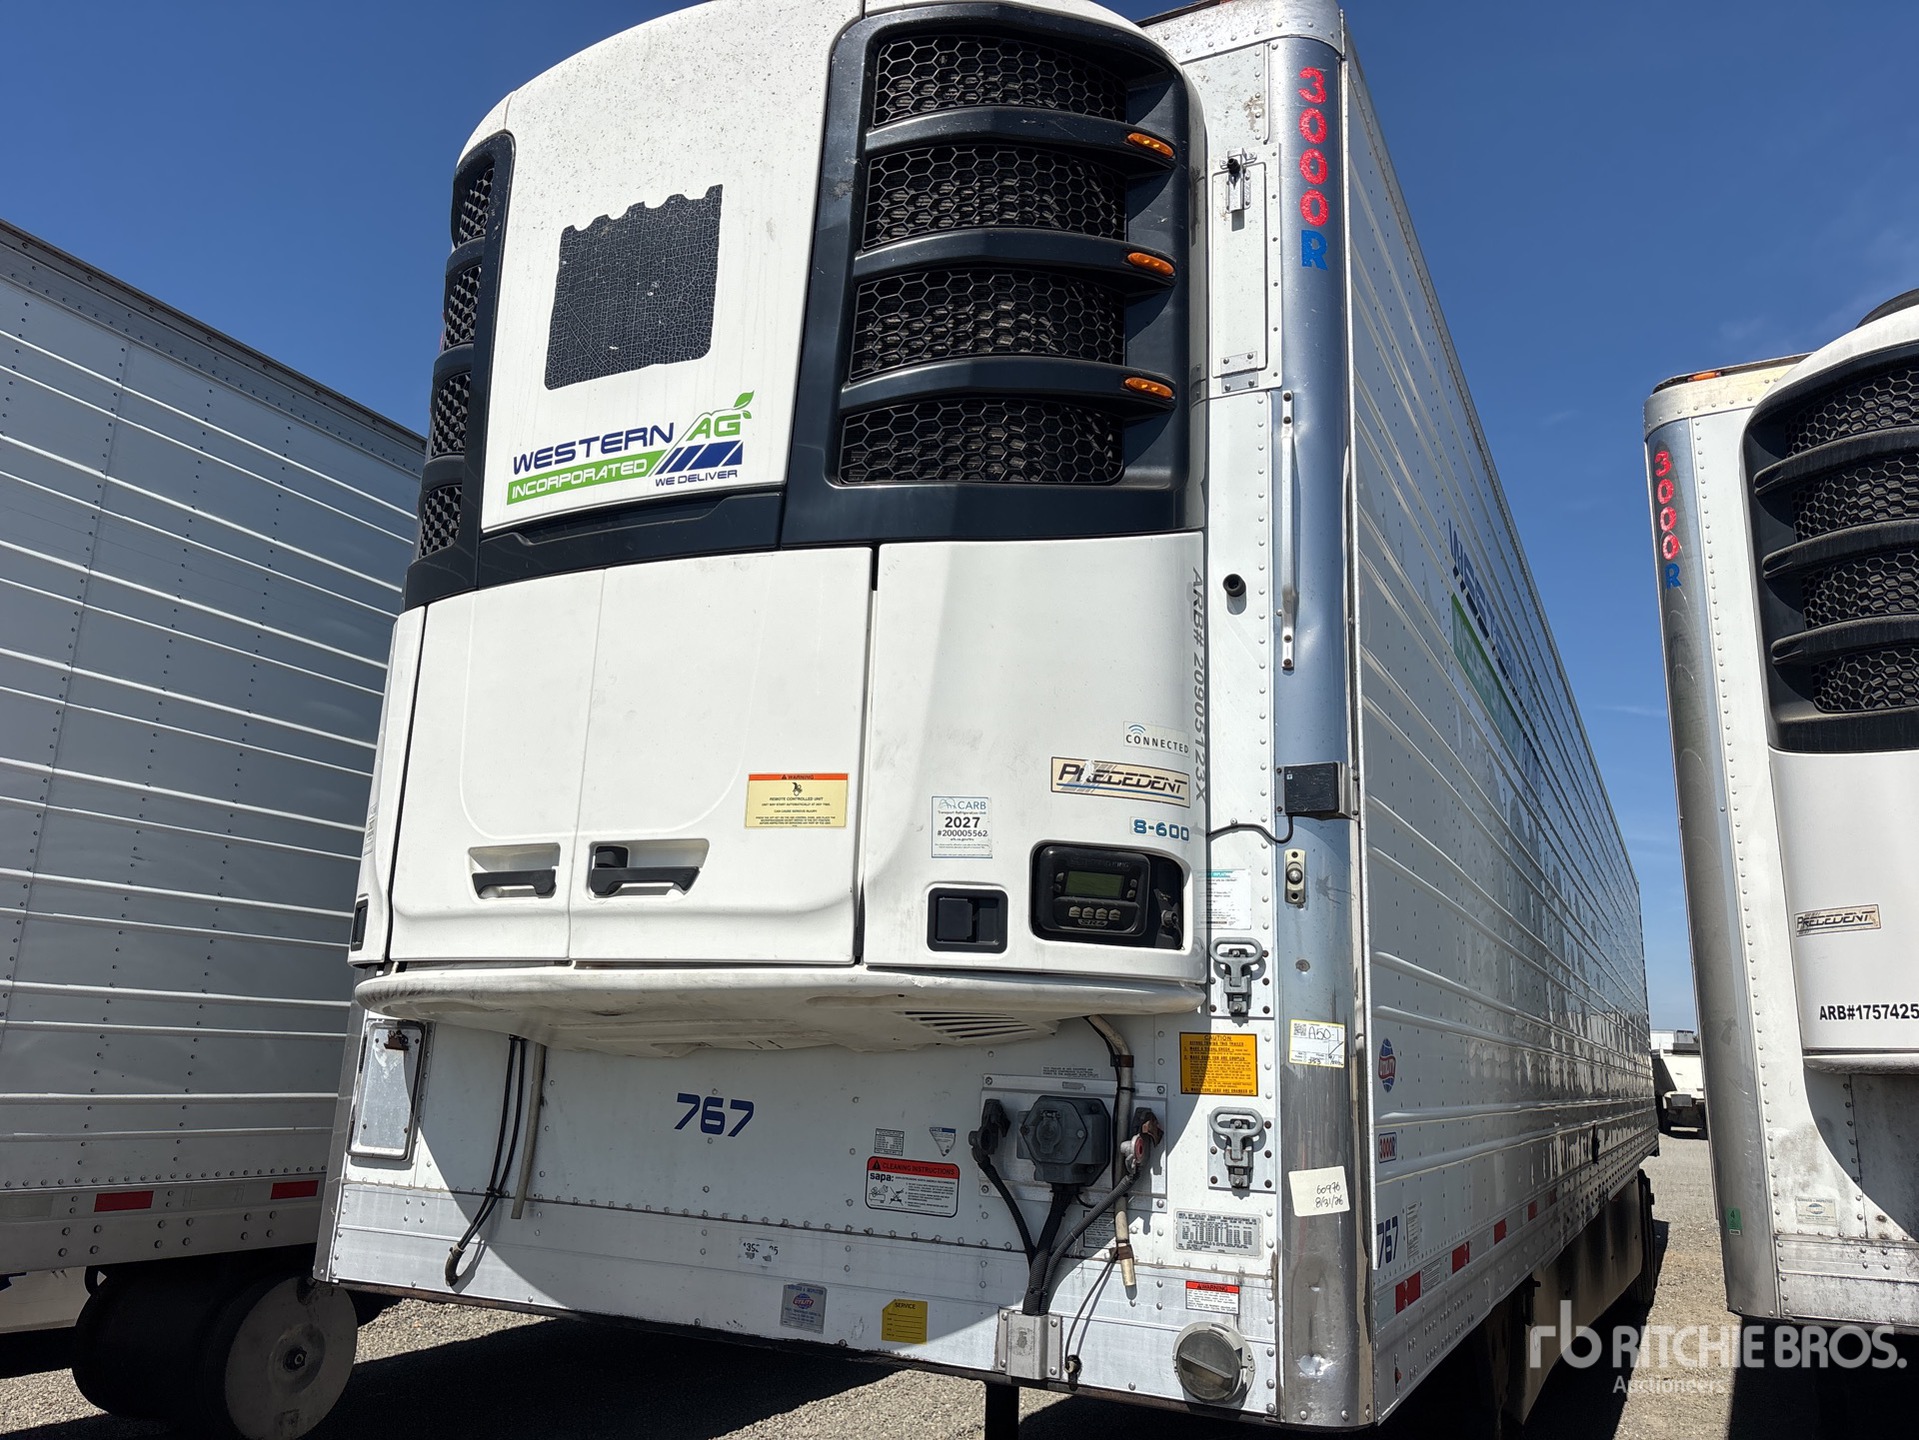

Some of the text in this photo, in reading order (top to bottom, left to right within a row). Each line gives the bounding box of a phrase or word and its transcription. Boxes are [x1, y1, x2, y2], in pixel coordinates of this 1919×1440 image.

[1298, 66, 1329, 271] 3000R
[513, 414, 741, 475] WESTERN AG
[512, 458, 648, 499] INCORPORATED
[655, 469, 738, 487] WE DELIVER
[1655, 451, 1682, 590] 3000R
[1193, 566, 1204, 647] ARB#
[1125, 734, 1189, 754] CONNECTED
[957, 800, 987, 810] CARB
[945, 816, 980, 828] 2027
[937, 829, 988, 837] #200005562
[1797, 910, 1876, 929] PRECEDENT
[1820, 1003, 1919, 1020] ARB#1757425
[673, 1092, 755, 1138] 767
[882, 1162, 912, 1171] CLEANING
[1377, 1216, 1398, 1268] 767
[894, 1302, 916, 1310] SERVICE
